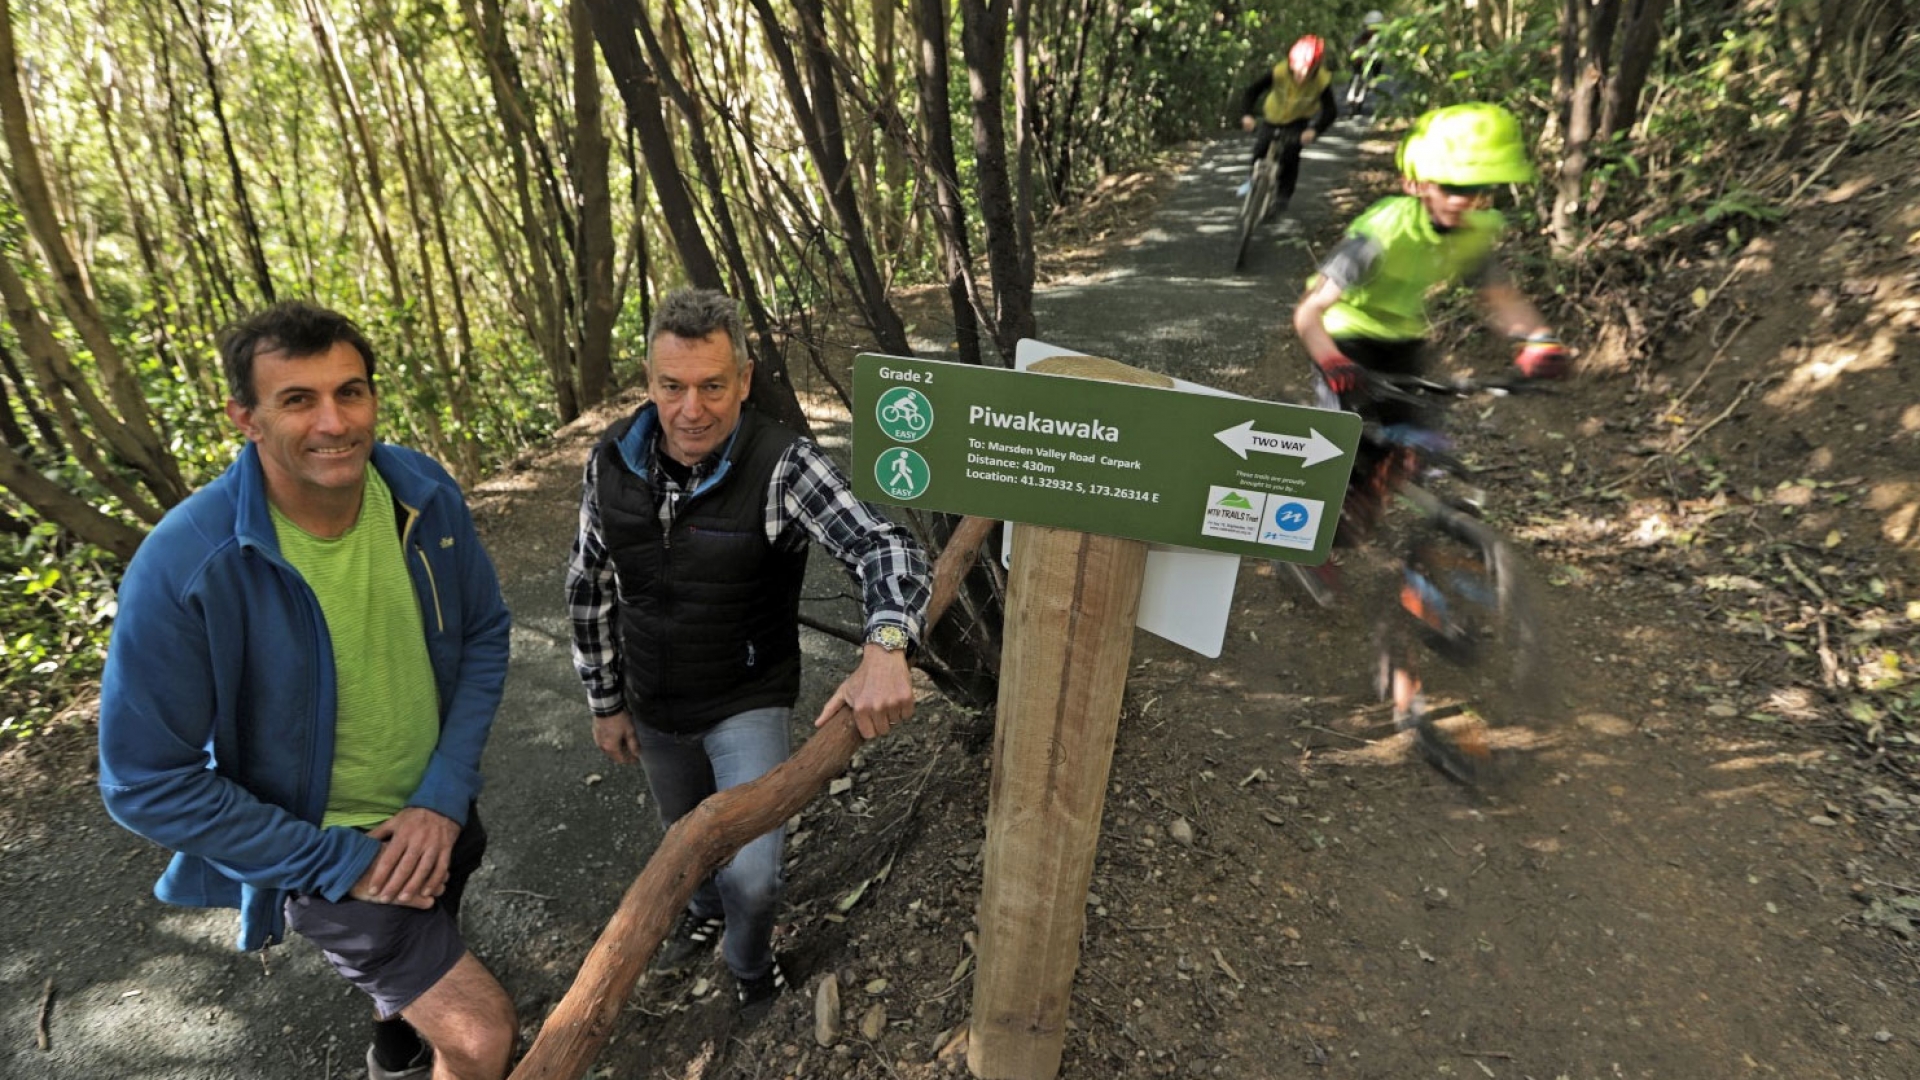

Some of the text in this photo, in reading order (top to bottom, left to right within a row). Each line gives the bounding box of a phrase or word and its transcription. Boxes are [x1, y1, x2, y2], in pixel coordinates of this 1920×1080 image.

[879, 366, 934, 384] Grade 2
[968, 405, 1119, 442] Piwakawaka
[894, 429, 917, 440] EASY
[1252, 436, 1306, 451] TWO WAY
[967, 453, 1055, 473] Distance: 430m
[968, 438, 1142, 470] To: Marsden Valley Road Carpark
[890, 487, 913, 497] EASY
[966, 468, 1160, 503] Location: 41.32932 S, 173.26314 E
[1221, 509, 1246, 520] TRAILS
